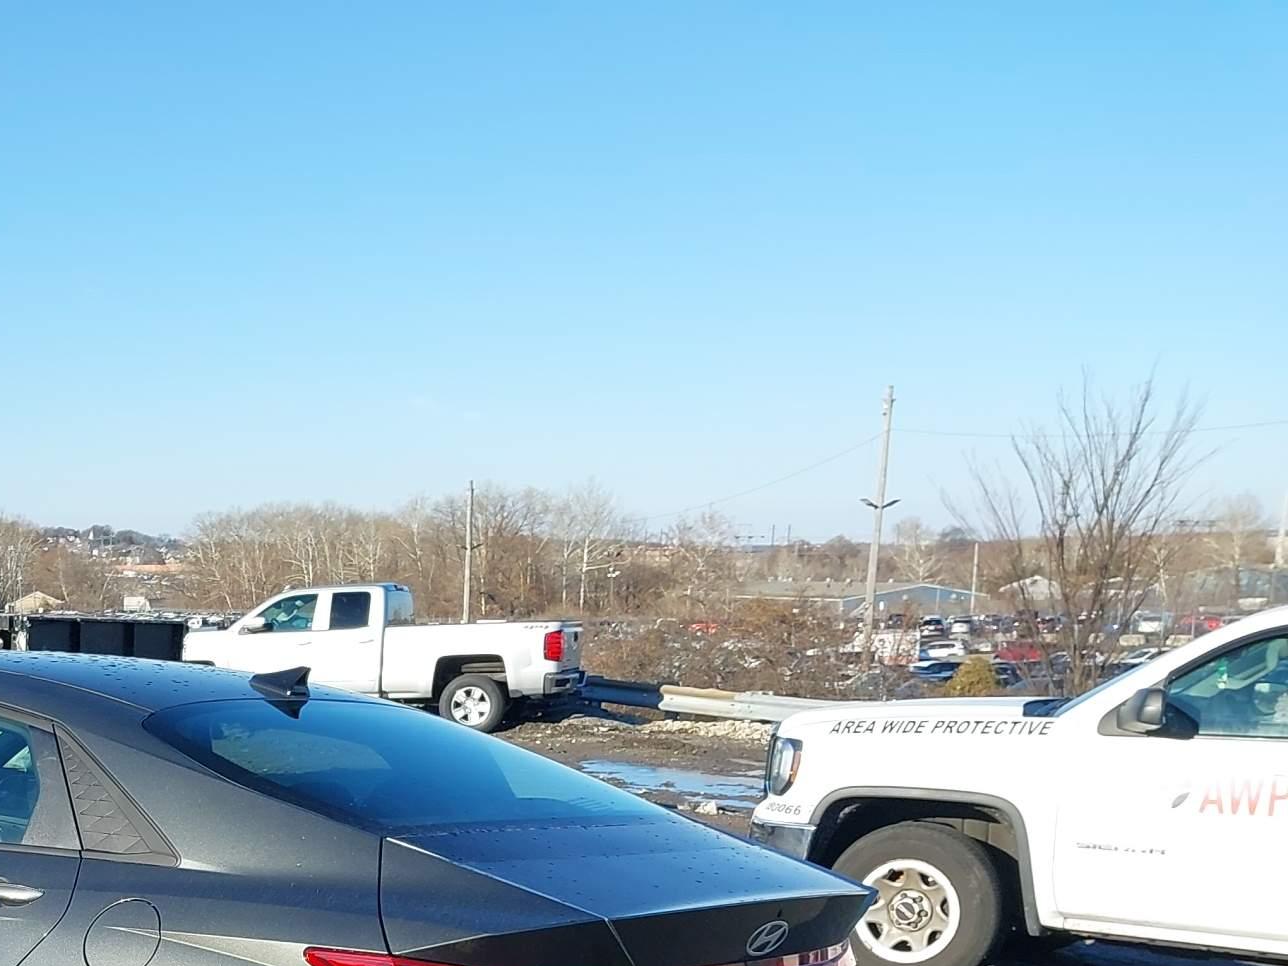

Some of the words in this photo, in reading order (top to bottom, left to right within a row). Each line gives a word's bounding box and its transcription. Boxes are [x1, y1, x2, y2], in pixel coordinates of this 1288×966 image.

[829, 720, 875, 735] AREA
[881, 720, 928, 735] WIDE
[930, 720, 1055, 736] PROTECTIVE
